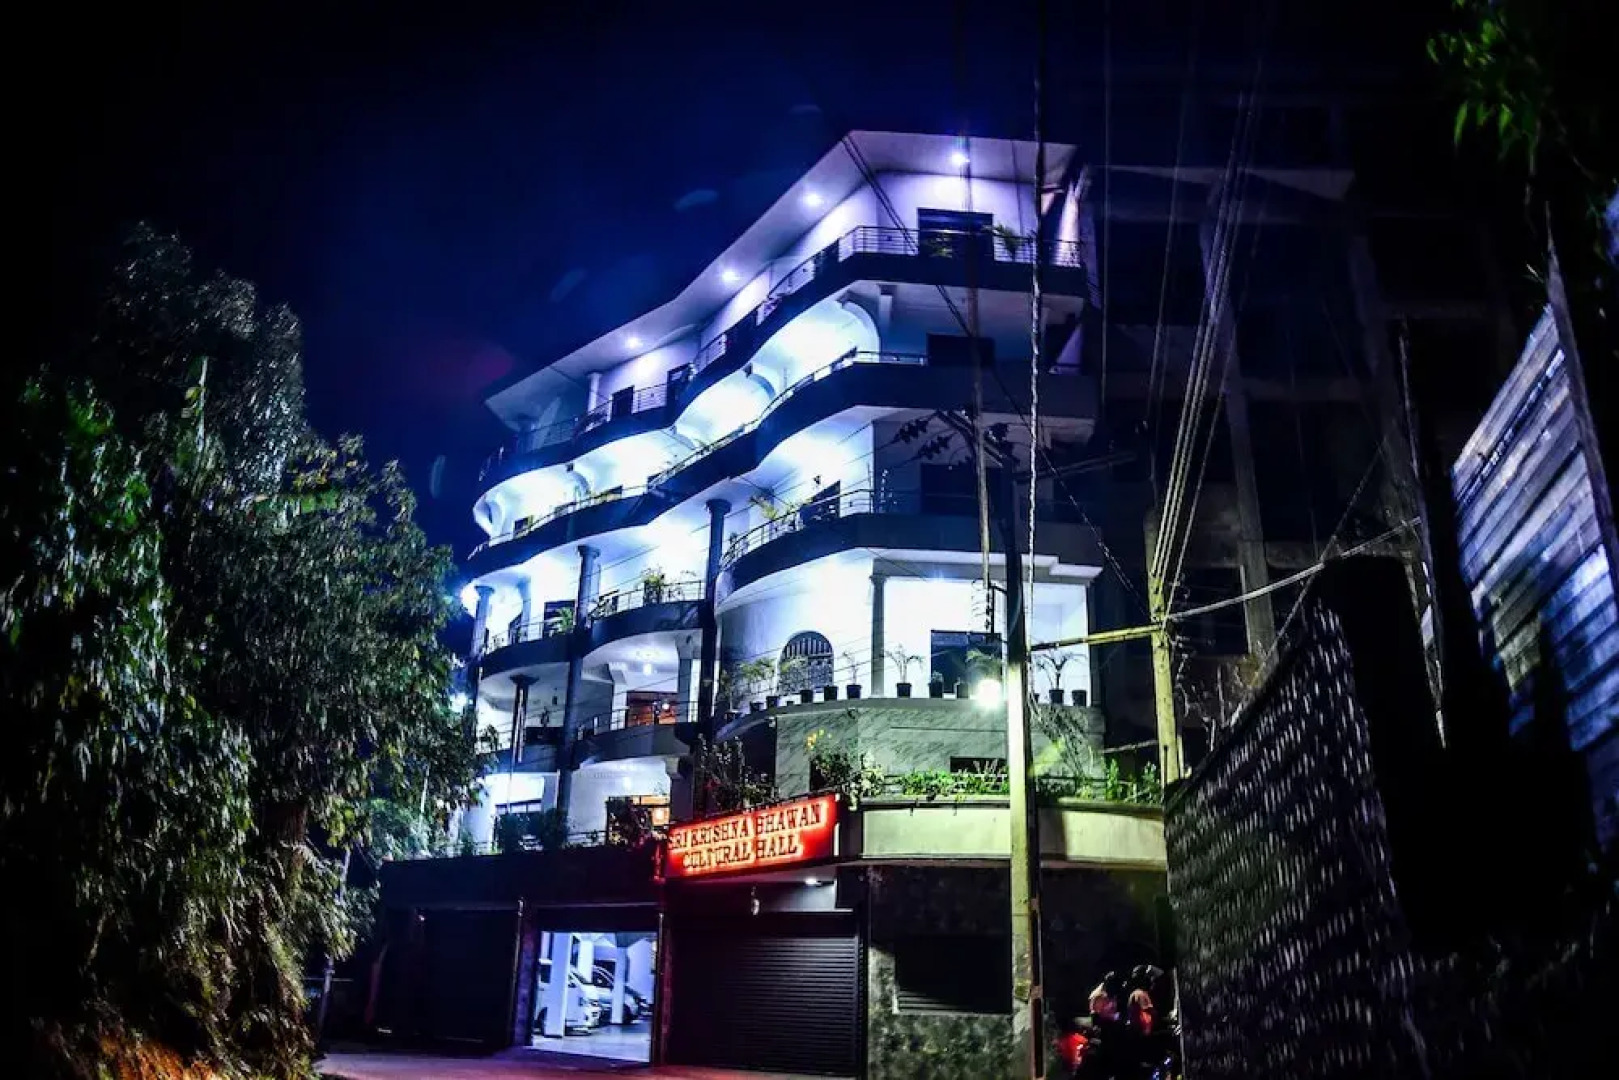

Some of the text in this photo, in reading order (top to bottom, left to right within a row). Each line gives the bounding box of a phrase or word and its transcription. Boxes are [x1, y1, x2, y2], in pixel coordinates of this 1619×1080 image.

[690, 817, 750, 847] KRISHNA
[755, 804, 823, 834] BHAWAN
[682, 834, 798, 868] CULTURAL HALL
